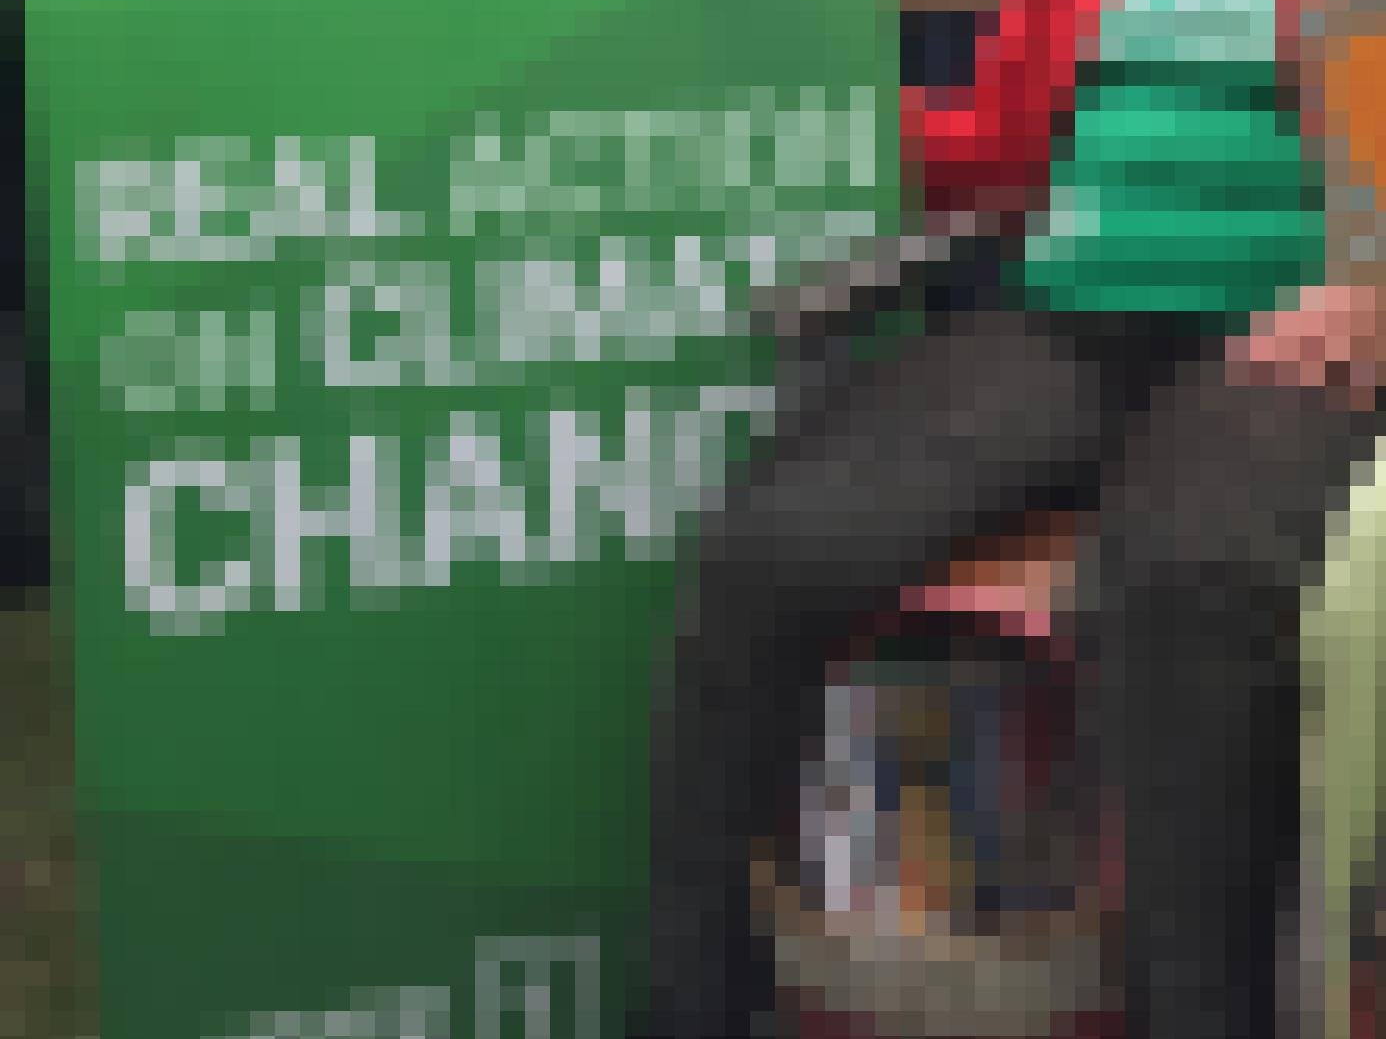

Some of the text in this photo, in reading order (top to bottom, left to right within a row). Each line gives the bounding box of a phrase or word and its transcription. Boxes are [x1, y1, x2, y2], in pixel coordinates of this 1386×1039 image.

[78, 91, 876, 264] REAL ACTION
[105, 215, 876, 411] ON CLIMAT
